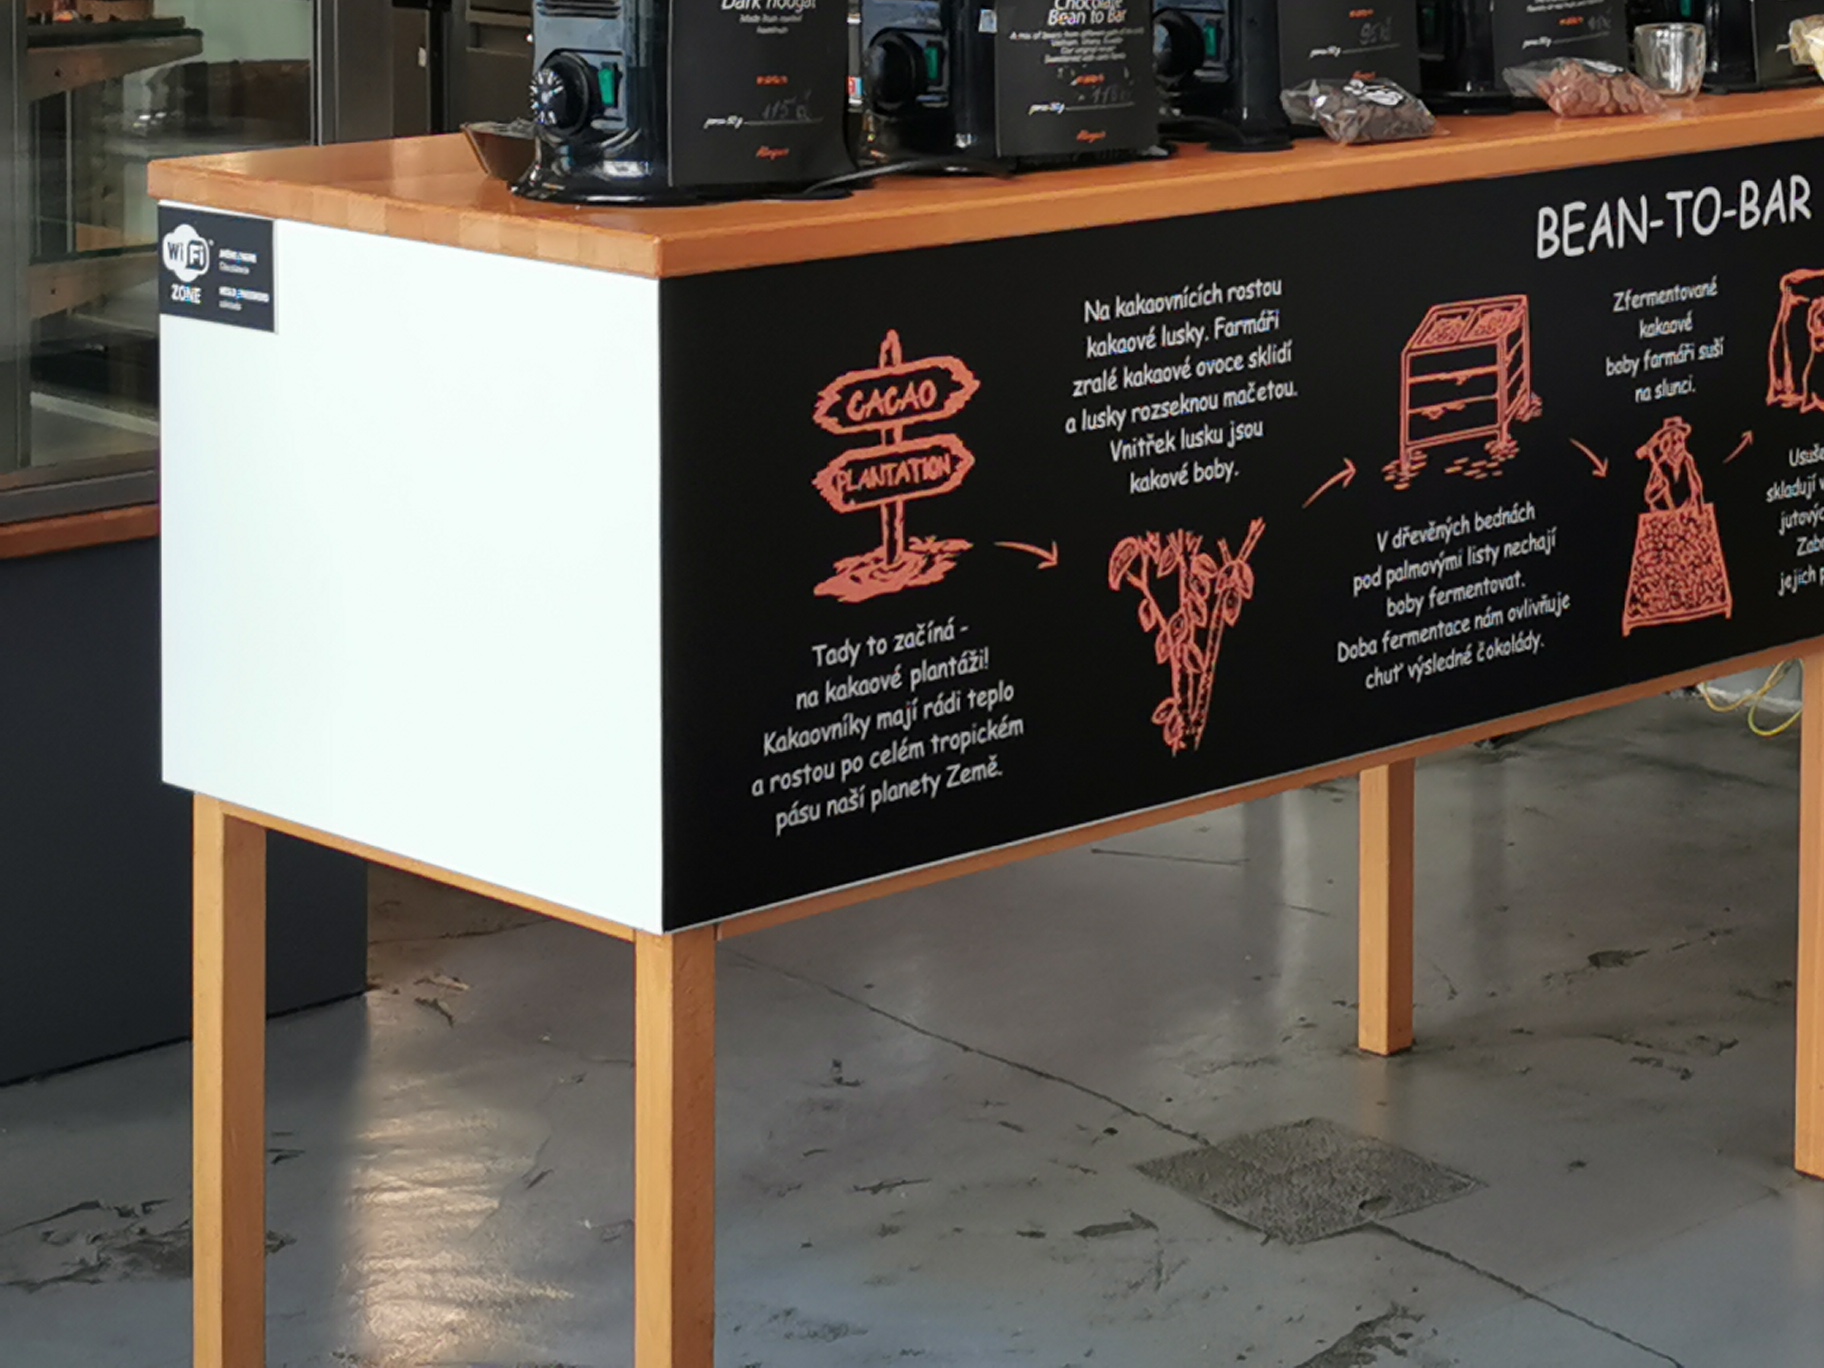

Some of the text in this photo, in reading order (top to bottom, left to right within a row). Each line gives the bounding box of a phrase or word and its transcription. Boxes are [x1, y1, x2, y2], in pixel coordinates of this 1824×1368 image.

[1047, 9, 1127, 26] Bean to Bar
[1535, 174, 1811, 260] BEAN-TO-BAR
[171, 283, 201, 304] ZONE
[1084, 278, 1282, 323] Na kakaovnících rostou
[1612, 274, 1718, 313] Zfermentované
[1086, 308, 1280, 359] kakaové lusky. Farmáři
[1639, 310, 1693, 340] kakaové
[1071, 339, 1293, 397] zralé kakaové ovoce sklidí
[1605, 336, 1725, 378] boby farmáři suší
[845, 379, 938, 423] CACAO
[1064, 380, 1298, 434] a lusky rozseknou mačetou.
[1635, 374, 1697, 403] na slunci.
[1109, 420, 1264, 462] Vnitřek lusku jsou
[834, 452, 952, 491] PLANTATION
[1129, 456, 1240, 494] kakové boby.
[1766, 472, 1817, 503] skladují
[1376, 500, 1536, 553] V dřevěných bednách
[1353, 526, 1557, 597] pod palmovými listy nechají
[1777, 564, 1817, 597] jejich
[1386, 570, 1525, 618] boby fermentovat.
[812, 616, 956, 669] Tady to začíná
[1337, 591, 1571, 663] Doba fermentace nám ovlivňuje
[796, 647, 990, 711] na kakaové plantáži!
[1365, 629, 1545, 690] chuť výsledné čokolády.
[763, 682, 1015, 756] Kakaovníky mají rádi teplo
[751, 715, 1025, 797] a rostou po celém tropickém
[775, 754, 1003, 837] pásu naší planety Země.
